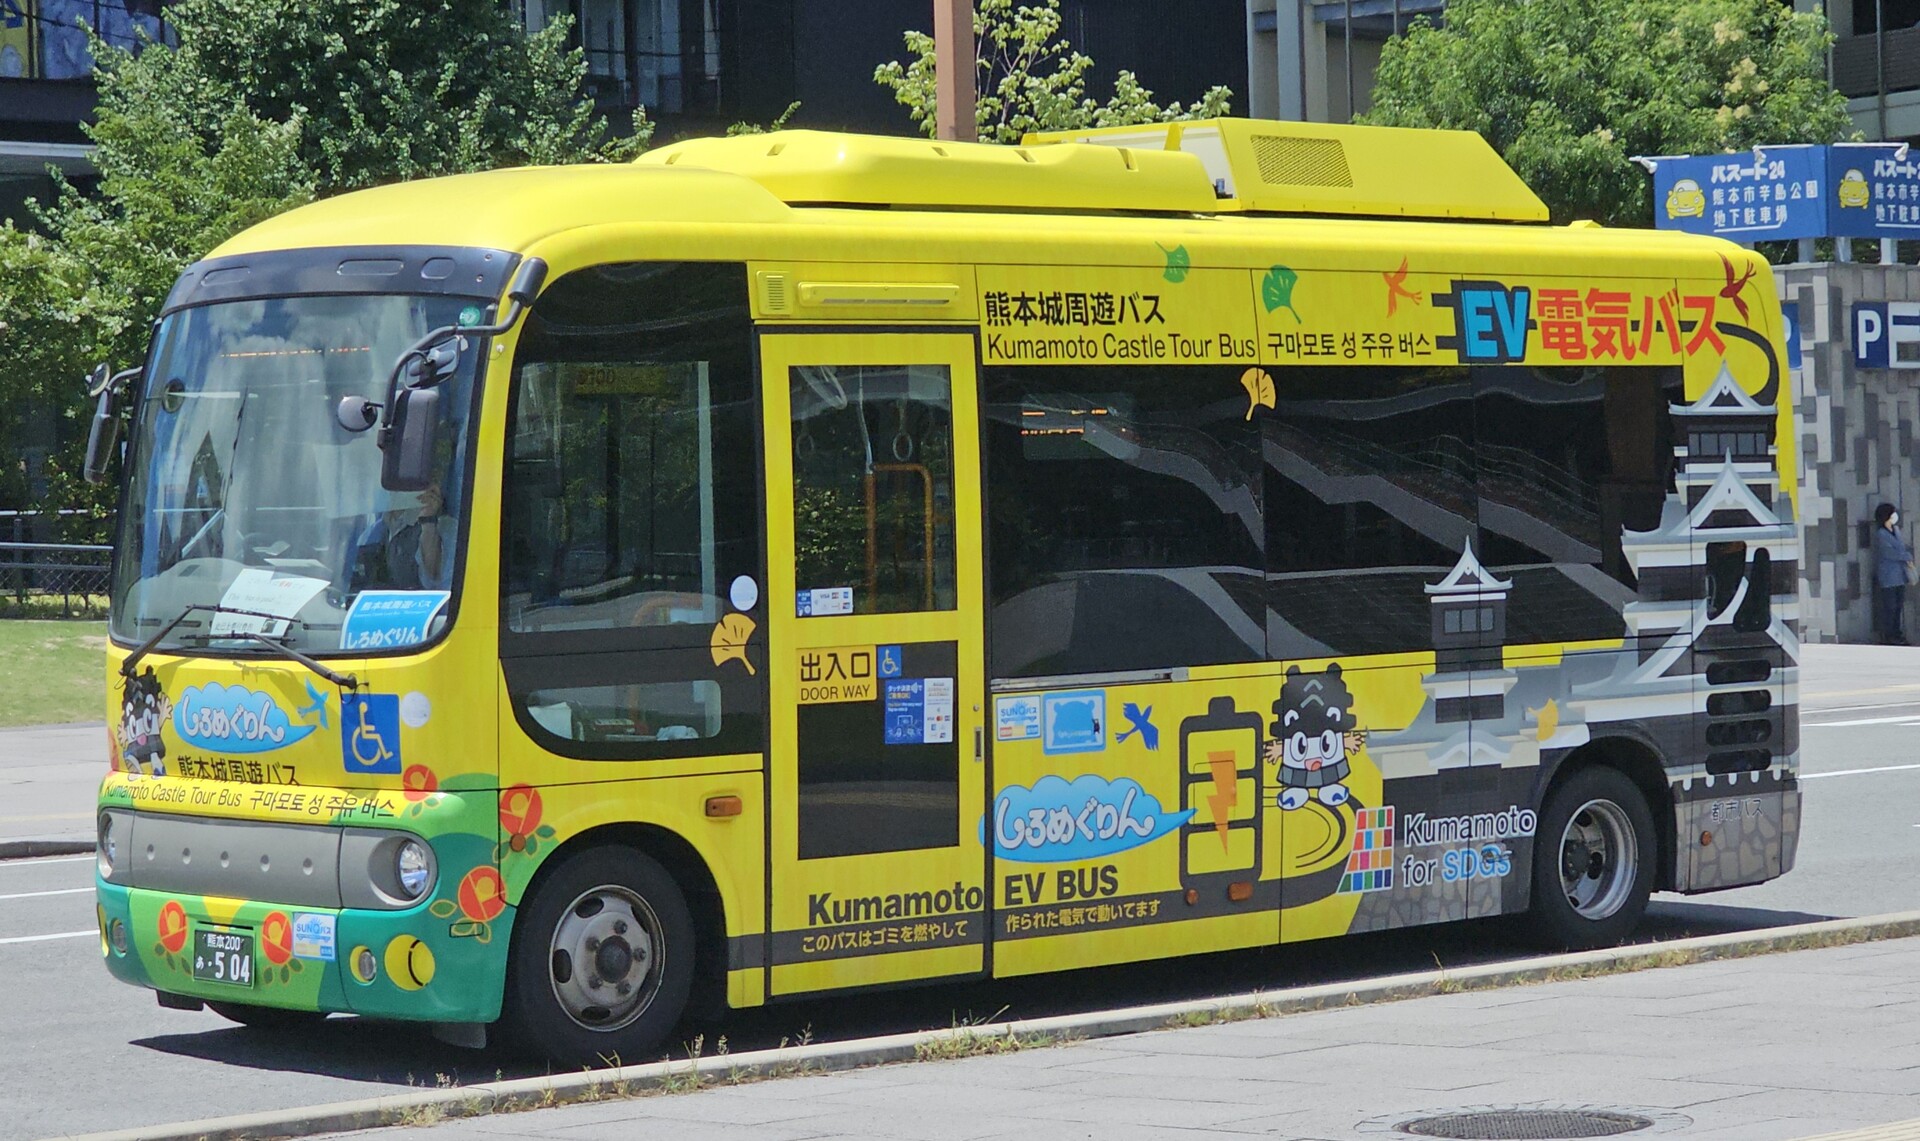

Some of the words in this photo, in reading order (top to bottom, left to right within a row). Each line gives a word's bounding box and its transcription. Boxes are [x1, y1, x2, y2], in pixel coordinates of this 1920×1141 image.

[1874, 160, 1920, 180] パスート
[1713, 180, 1818, 206] 熊本市辛島公園
[1714, 205, 1788, 227] 地下駐車場
[984, 290, 1166, 327] 熊本城周遊バス
[1461, 289, 1530, 358] EV
[1537, 287, 1727, 361] 電気バス
[1857, 309, 1882, 359] P
[987, 332, 1098, 359] Kumamoto
[1102, 332, 1166, 359] Castle
[1168, 333, 1212, 359] Tour
[1218, 333, 1256, 358] Bus
[1267, 332, 1337, 359] 구마모토
[1341, 332, 1357, 359] 성
[1361, 332, 1395, 359] 주유
[1398, 332, 1432, 358] 버스
[346, 626, 420, 650] しろめぐりん
[801, 652, 871, 682] 出入口
[801, 686, 838, 701] DOOR
[843, 684, 871, 699] WAY
[182, 696, 285, 743] しろめぐりん
[177, 755, 301, 787] 熊本城周遊バス
[103, 781, 148, 801] Kumamoto
[151, 785, 186, 804] Castle
[189, 786, 216, 805] Tour
[218, 788, 243, 808] Bus
[250, 790, 307, 812] 구마모토
[308, 795, 325, 816] 성
[325, 796, 358, 819] 주유
[361, 797, 395, 819] 버스
[996, 787, 1155, 850] しろめぐりん
[1404, 805, 1537, 847] Kumamoto
[1711, 798, 1764, 824] 都市バス
[1402, 854, 1436, 887] for
[1442, 844, 1512, 881] SDGs
[808, 881, 983, 926] Kumamoto
[1004, 872, 1047, 907] EV
[1056, 864, 1119, 901] BUS
[802, 920, 968, 953] このバスはゴミを燃やして
[1005, 899, 1162, 934] 作られた電気で動いてます
